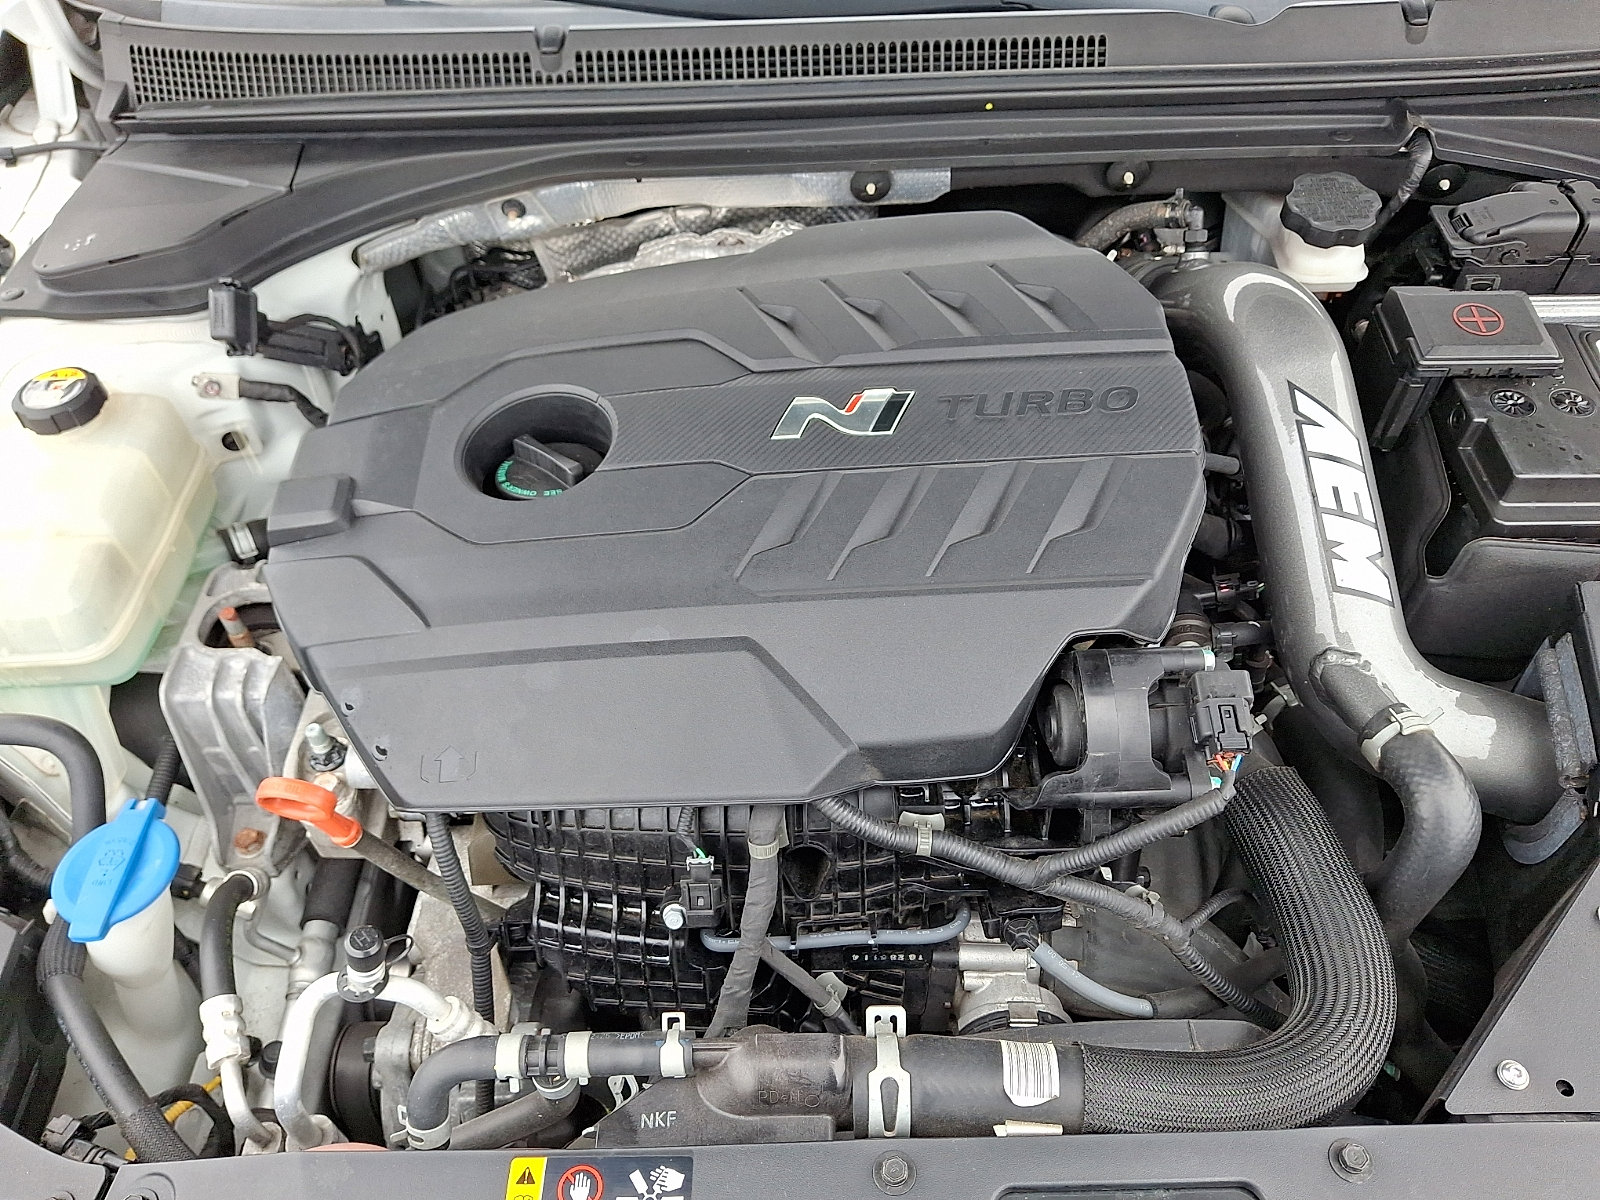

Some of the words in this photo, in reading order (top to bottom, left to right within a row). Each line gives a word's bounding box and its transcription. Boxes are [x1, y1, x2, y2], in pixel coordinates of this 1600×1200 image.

[943, 384, 1140, 421] TURBO
[1287, 380, 1396, 609] AEM
[640, 1110, 677, 1129] NKF
